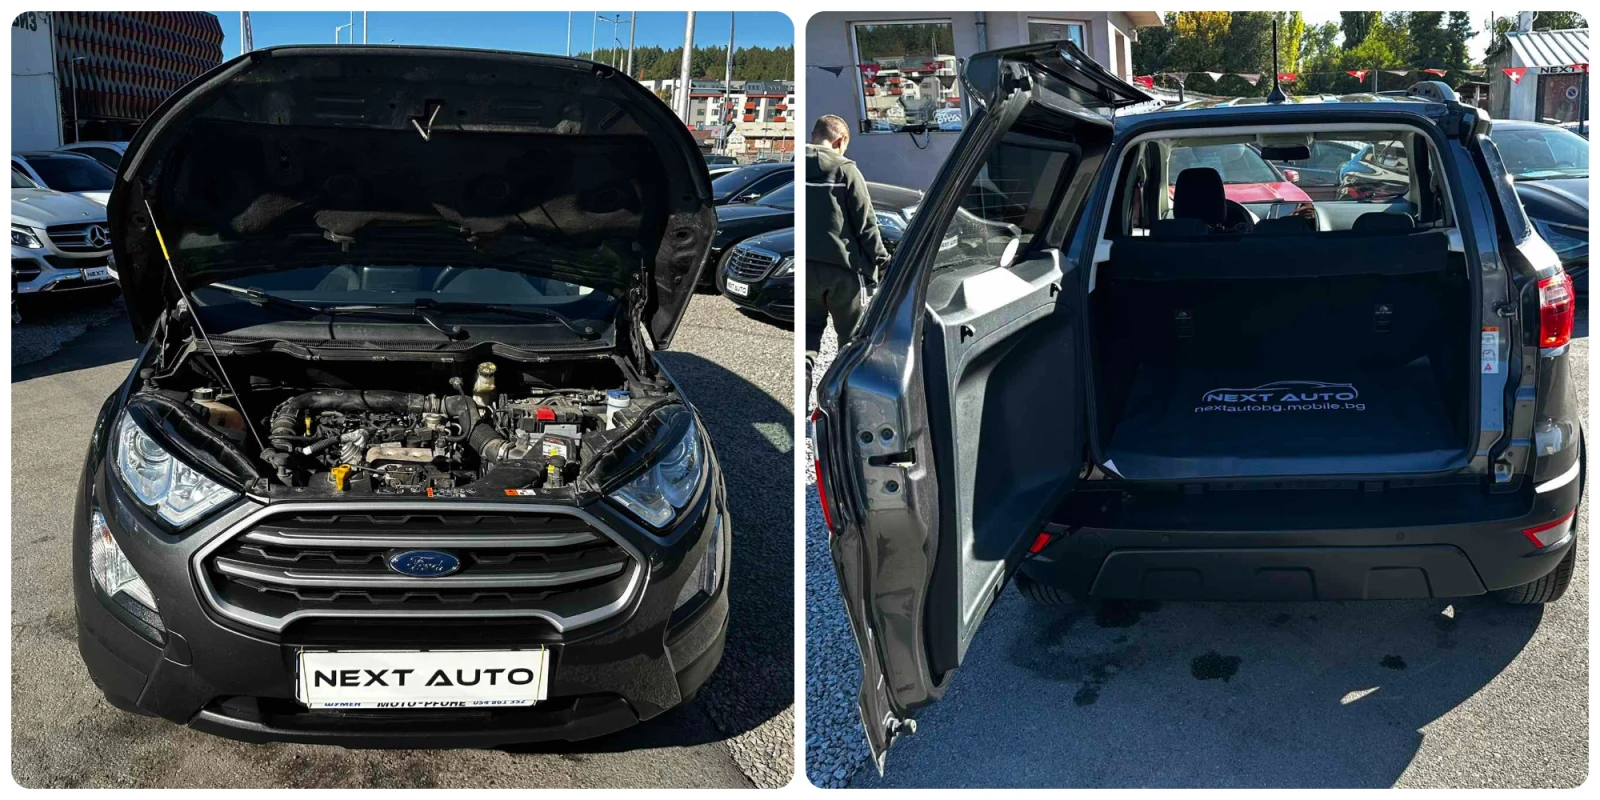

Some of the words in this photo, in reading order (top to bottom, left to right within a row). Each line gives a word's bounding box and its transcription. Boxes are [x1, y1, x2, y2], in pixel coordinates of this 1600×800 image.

[1541, 66, 1576, 74] NEXT
[1207, 393, 1274, 402] NEXT
[1280, 392, 1355, 401] AUTO
[1194, 402, 1366, 413] nextautobg.mobile.bg
[407, 556, 443, 571] Ford
[314, 669, 415, 687] NEXT
[425, 668, 534, 686] AUTO
